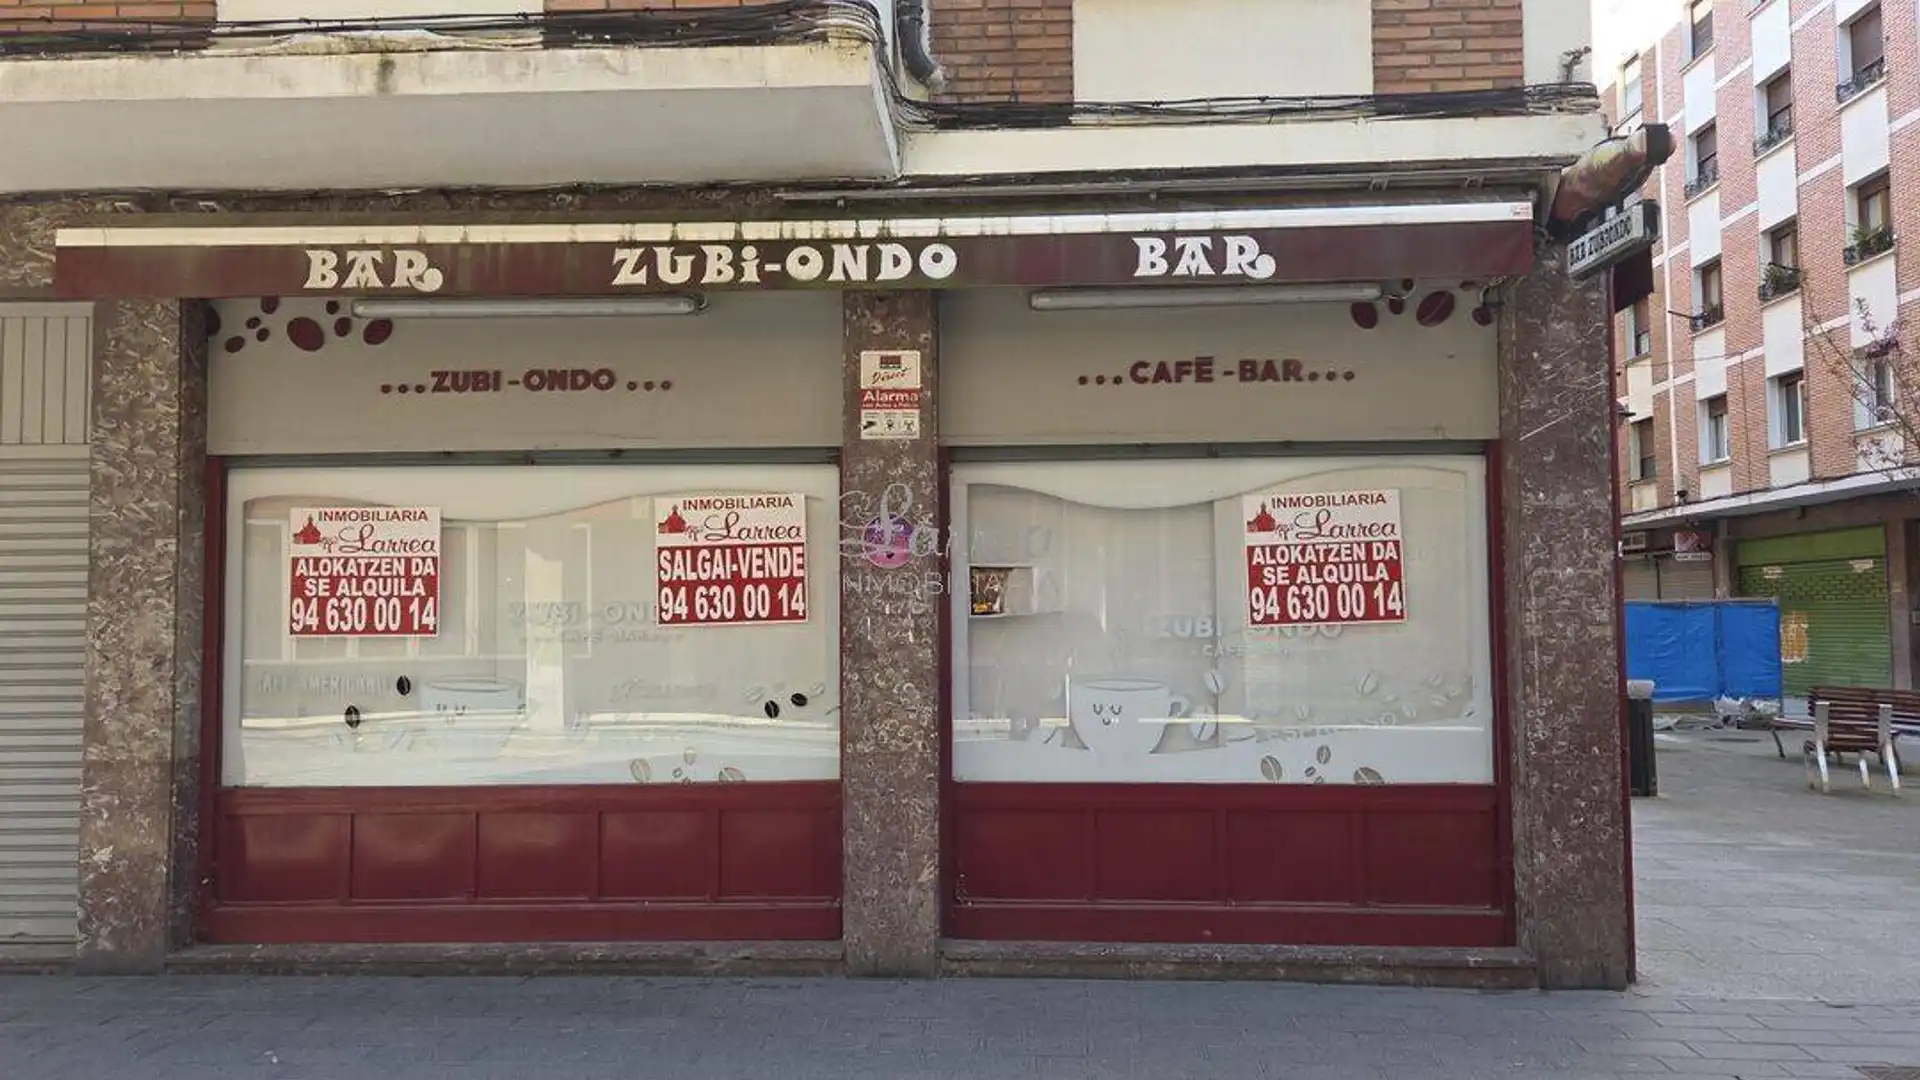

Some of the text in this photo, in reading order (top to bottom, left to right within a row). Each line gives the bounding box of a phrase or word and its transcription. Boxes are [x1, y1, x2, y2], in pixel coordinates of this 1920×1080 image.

[303, 250, 443, 292] BAR
[1132, 235, 1276, 279] BAR
[863, 390, 919, 403] Alarma
[318, 510, 428, 522] INMOBILIARIA
[683, 497, 793, 510] INMOBILIARIA
[1272, 493, 1387, 509] INMOBILIARIA
[338, 523, 436, 553] Larrea
[704, 511, 801, 541] Larrea
[1294, 508, 1397, 539] Larrea
[295, 558, 435, 576] ALOKATZEN DA
[659, 546, 804, 581] SALGAI-VENDE
[1252, 541, 1398, 565] ALOKATZEN DA
[304, 577, 425, 597] SE ALQUILA
[1262, 562, 1389, 585] SE ALQUILA
[291, 597, 436, 631] 94 630 00 14
[660, 583, 805, 621] 94 630 00 14
[1251, 581, 1402, 622] 94 630 00 14
